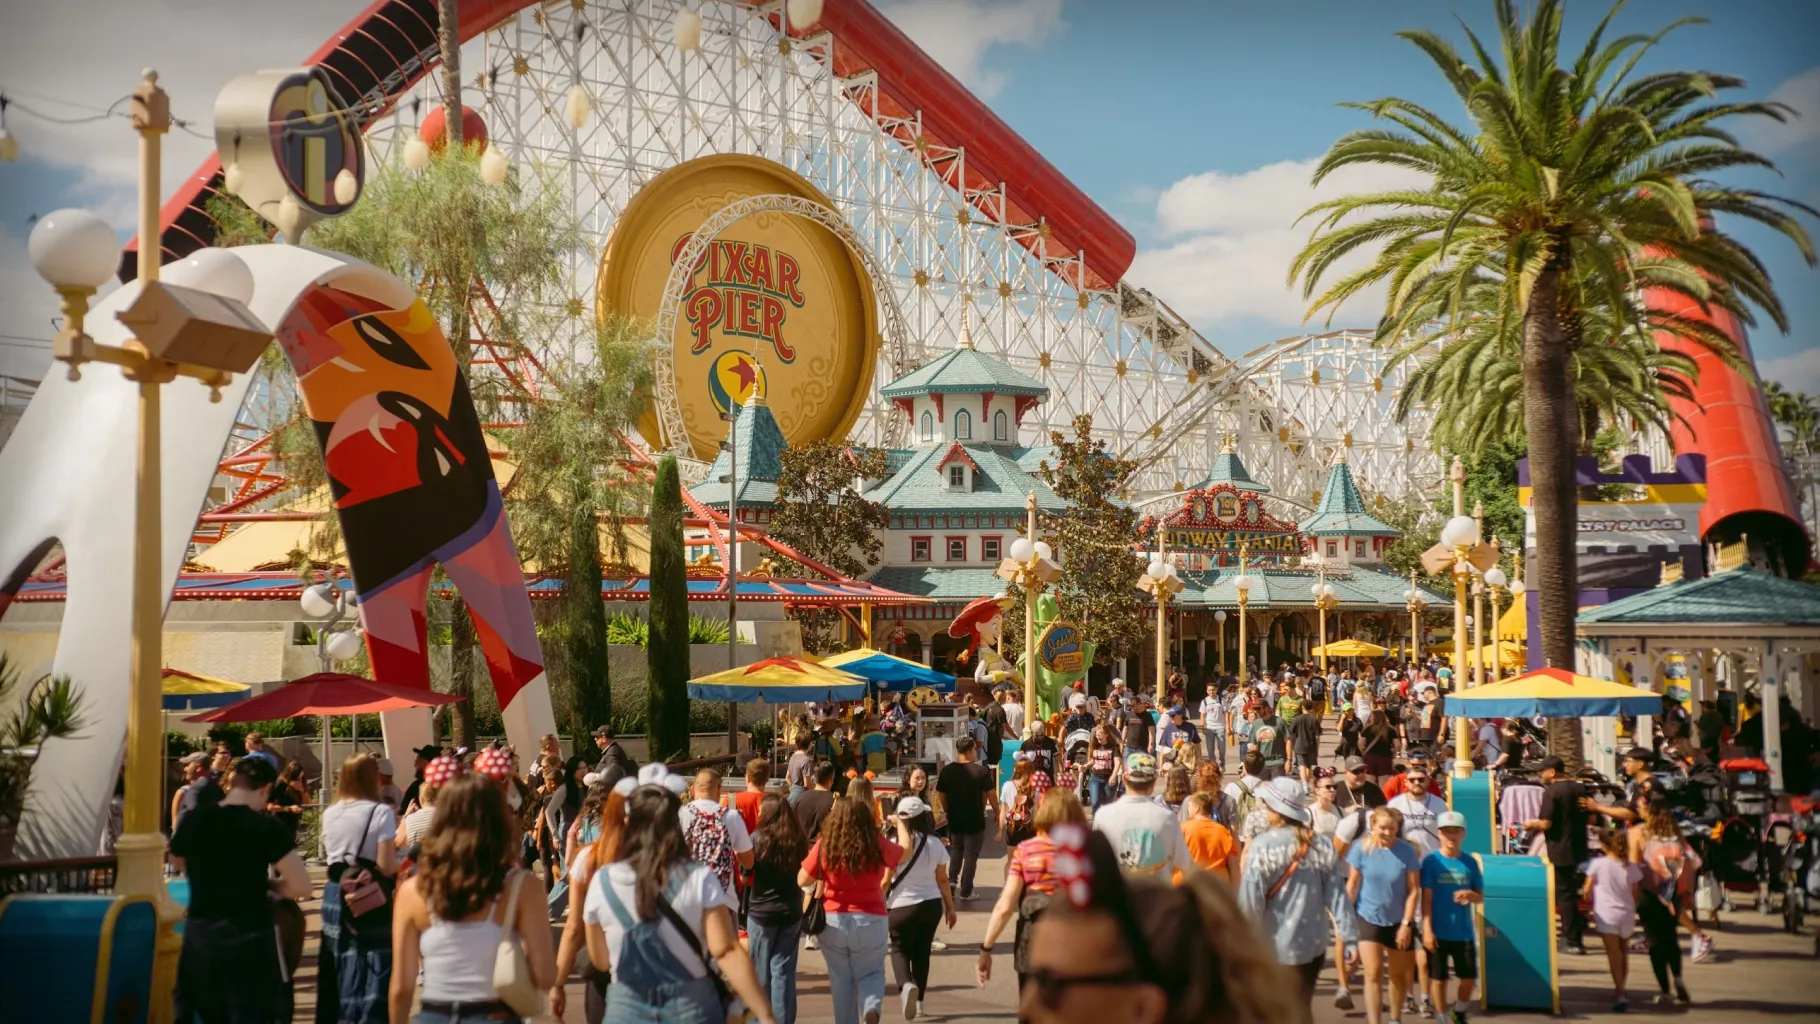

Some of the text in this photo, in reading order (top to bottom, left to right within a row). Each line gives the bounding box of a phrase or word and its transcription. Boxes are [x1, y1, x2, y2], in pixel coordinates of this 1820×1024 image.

[671, 232, 805, 307] PIXAR
[686, 286, 796, 363] PIER
[1220, 497, 1236, 509] TOY
[1577, 518, 1686, 533] LTRY PALACE
